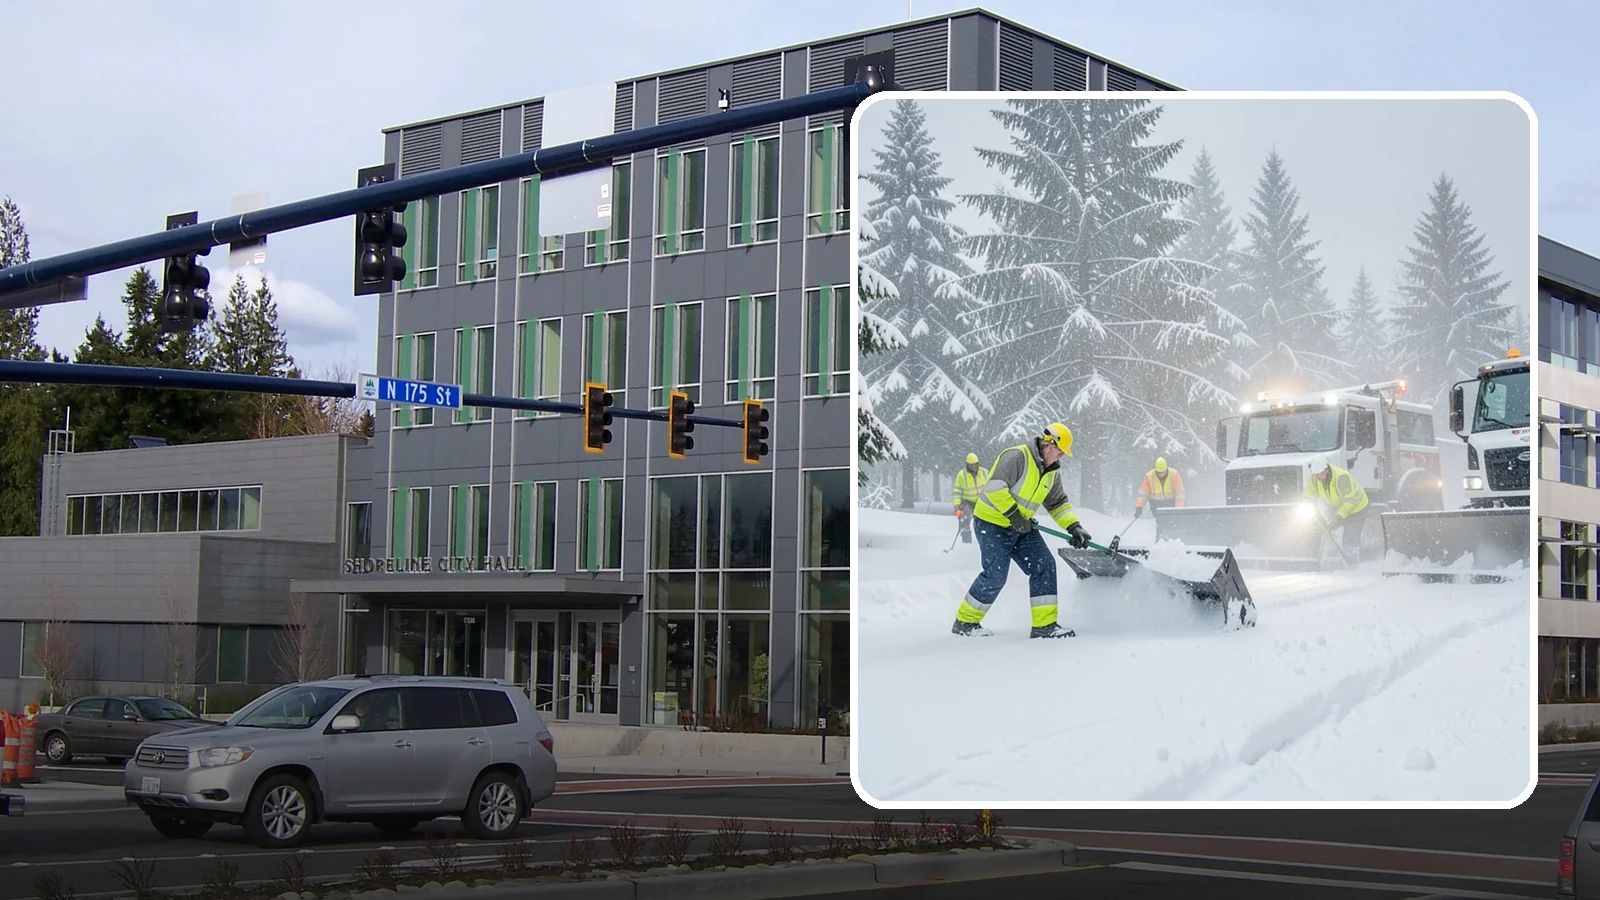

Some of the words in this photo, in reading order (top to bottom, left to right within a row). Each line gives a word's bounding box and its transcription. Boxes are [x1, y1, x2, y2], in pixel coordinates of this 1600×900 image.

[387, 380, 396, 400] N
[405, 382, 427, 403] 175
[436, 386, 451, 406] St
[343, 557, 432, 575] SHORELINE
[438, 556, 475, 573] CITY
[484, 556, 526, 572] HALL
